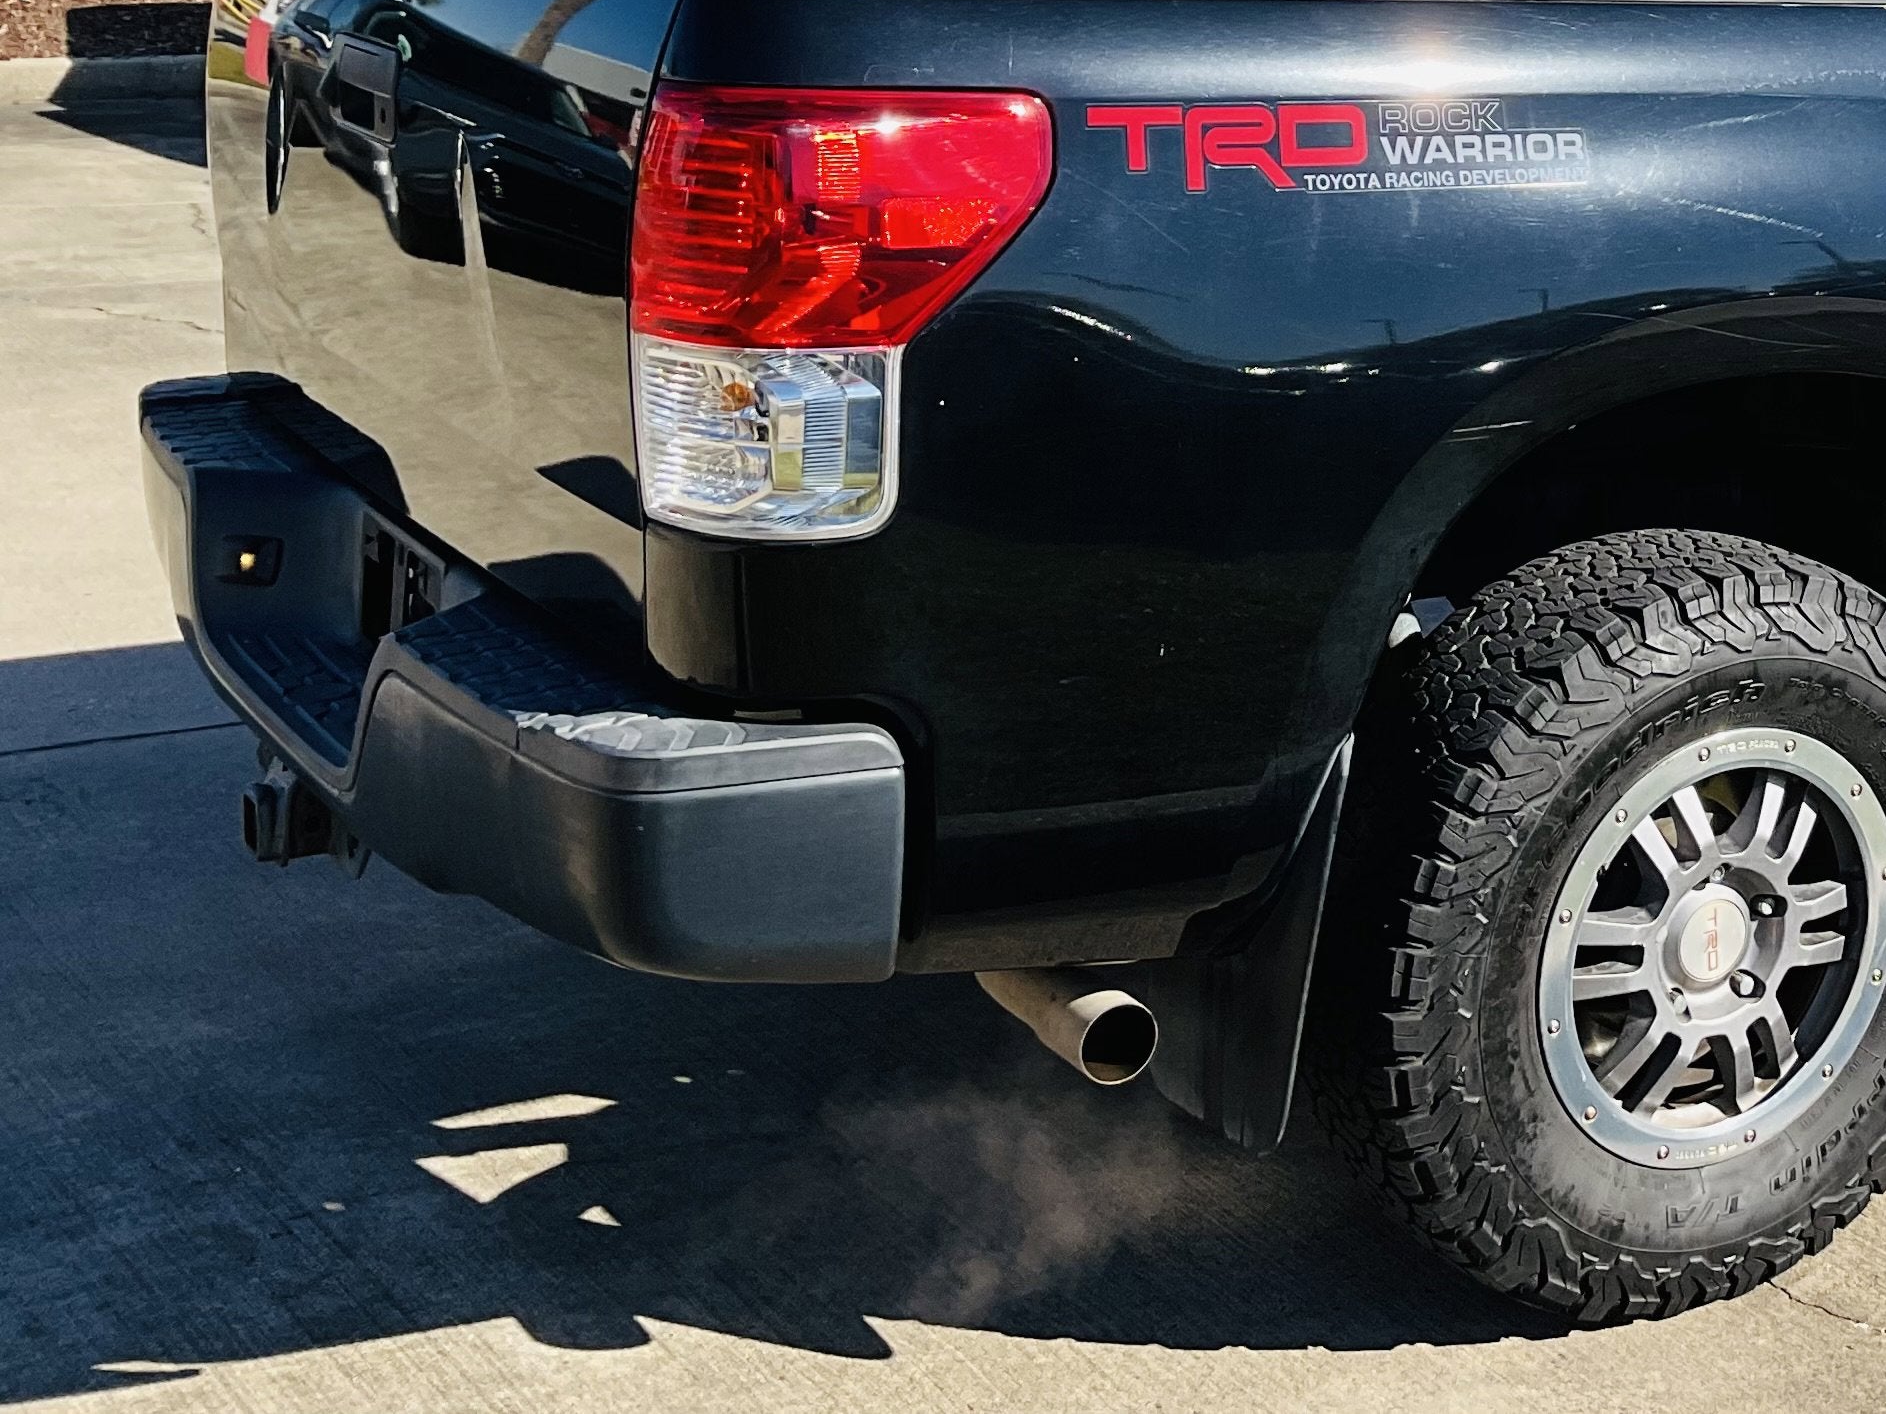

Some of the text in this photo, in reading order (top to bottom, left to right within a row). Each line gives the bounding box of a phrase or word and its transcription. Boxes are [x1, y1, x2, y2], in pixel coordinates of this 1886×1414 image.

[1378, 100, 1503, 134] ROCK
[1086, 103, 1368, 192] TRD
[1379, 131, 1585, 165] WARRIOR
[1303, 165, 1588, 191] TOYOTA RACING DEVELOPMENT
[1703, 907, 1718, 972] TRD
[1665, 1192, 1744, 1230] T/A
